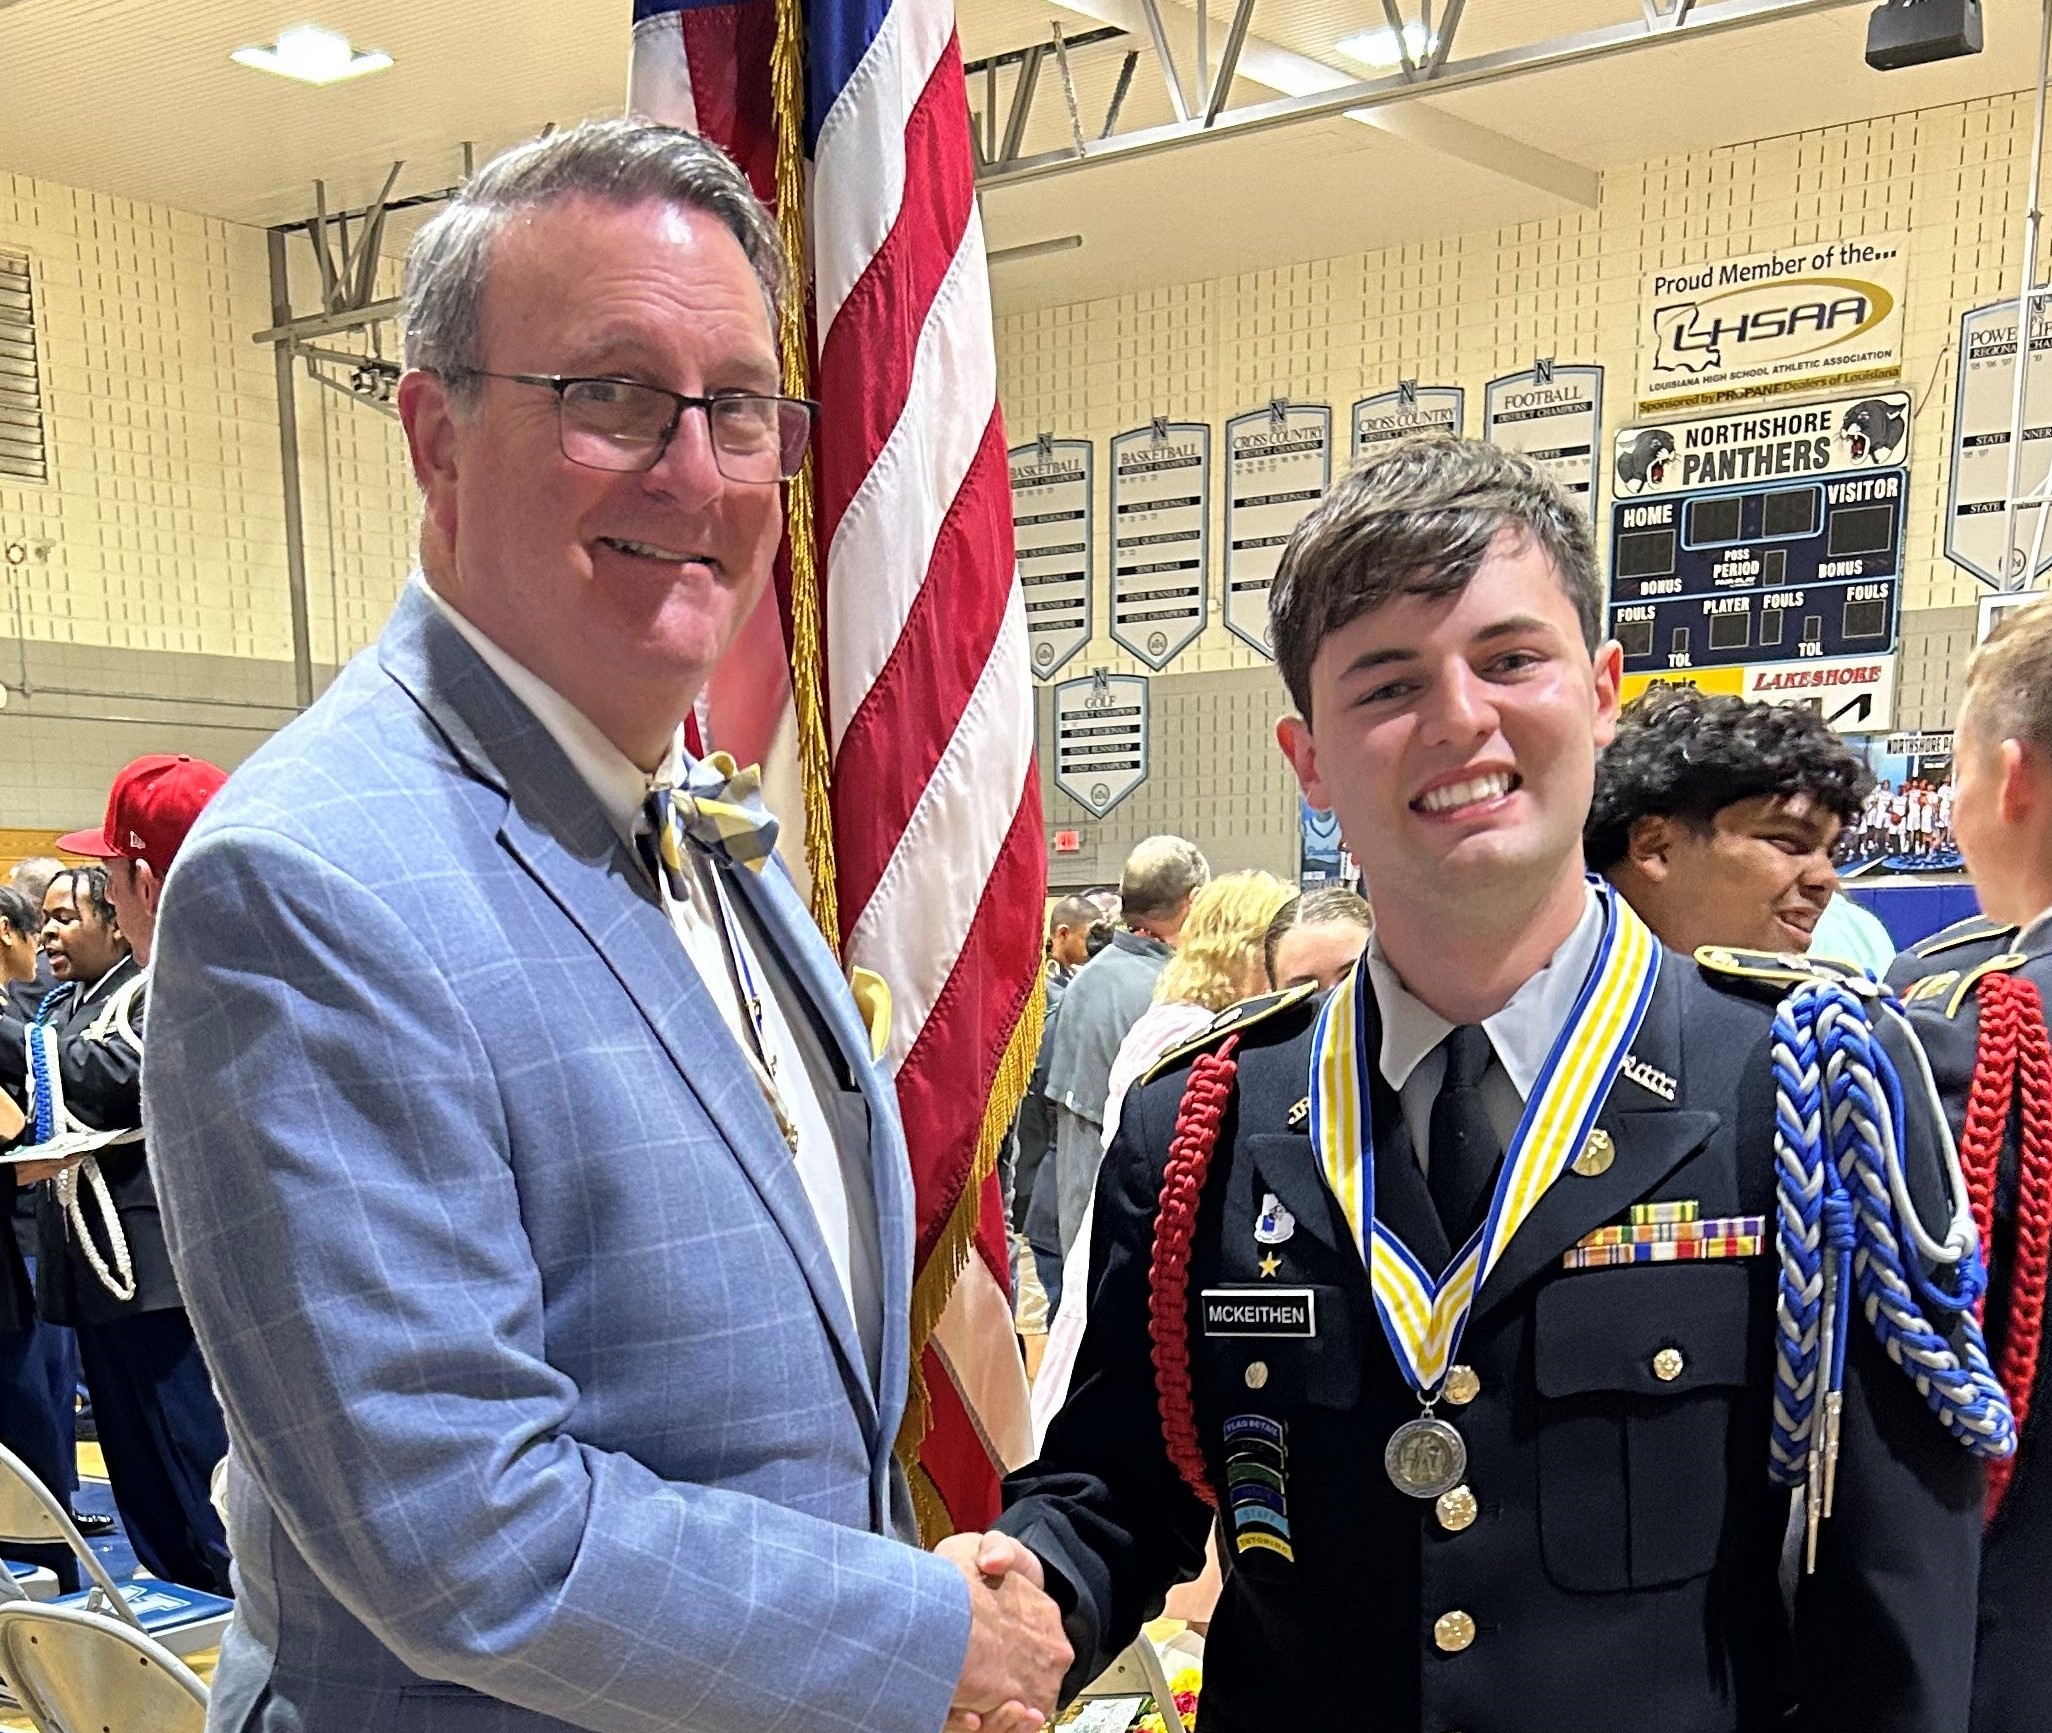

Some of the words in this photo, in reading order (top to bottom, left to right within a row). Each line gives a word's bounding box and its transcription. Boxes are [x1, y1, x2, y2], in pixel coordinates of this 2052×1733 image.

[1654, 266, 1713, 296] Proud
[1719, 255, 1807, 286] Member
[1812, 245, 1835, 271] of
[1840, 242, 1897, 266] the...
[1673, 295, 1867, 351] LHSAA
[1533, 357, 1555, 386] N
[1649, 377, 1700, 392] LOUISIANA
[1703, 373, 1727, 384] HIGH
[1729, 367, 1770, 380] SCHOOL
[1772, 360, 1821, 374] ATHLETIC
[1823, 350, 1893, 366] ASSOCIATION
[1504, 386, 1582, 409] FOOTBALL
[1640, 393, 1699, 413] Sponsored
[1701, 391, 1715, 404] by
[1843, 367, 1900, 382] Louisiana
[1360, 415, 1396, 432] CROSS
[1397, 407, 1454, 427] COUNTRY
[1685, 410, 1832, 448] NORTHSHORE
[1233, 432, 1268, 450] CROSS
[1270, 425, 1323, 445] COUNTRY
[1975, 432, 2006, 446] STATE
[1121, 443, 1197, 465] BASKETBALL
[1682, 436, 1831, 485] PANTHERS
[1827, 477, 1899, 505] VISITOR
[1623, 504, 1674, 529] HOME
[1970, 502, 2001, 514] STATE
[1724, 548, 1750, 562] POSS
[1713, 560, 1760, 579] PERIOD
[1818, 560, 1863, 579] BONUS
[1640, 577, 1683, 596] BONUS
[1846, 583, 1889, 602] FOULS
[1617, 605, 1656, 622] FOULS
[1703, 596, 1750, 615] PLAYER
[1763, 591, 1804, 609] FOULS
[1667, 652, 1692, 668] TOL
[1798, 641, 1824, 658] TOL
[1752, 665, 1882, 691] LAKESHORE
[1085, 695, 1117, 709] GOLF
[1886, 737, 1942, 755] NORTHSHORE
[1208, 1305, 1305, 1324] MCKEITHEN
